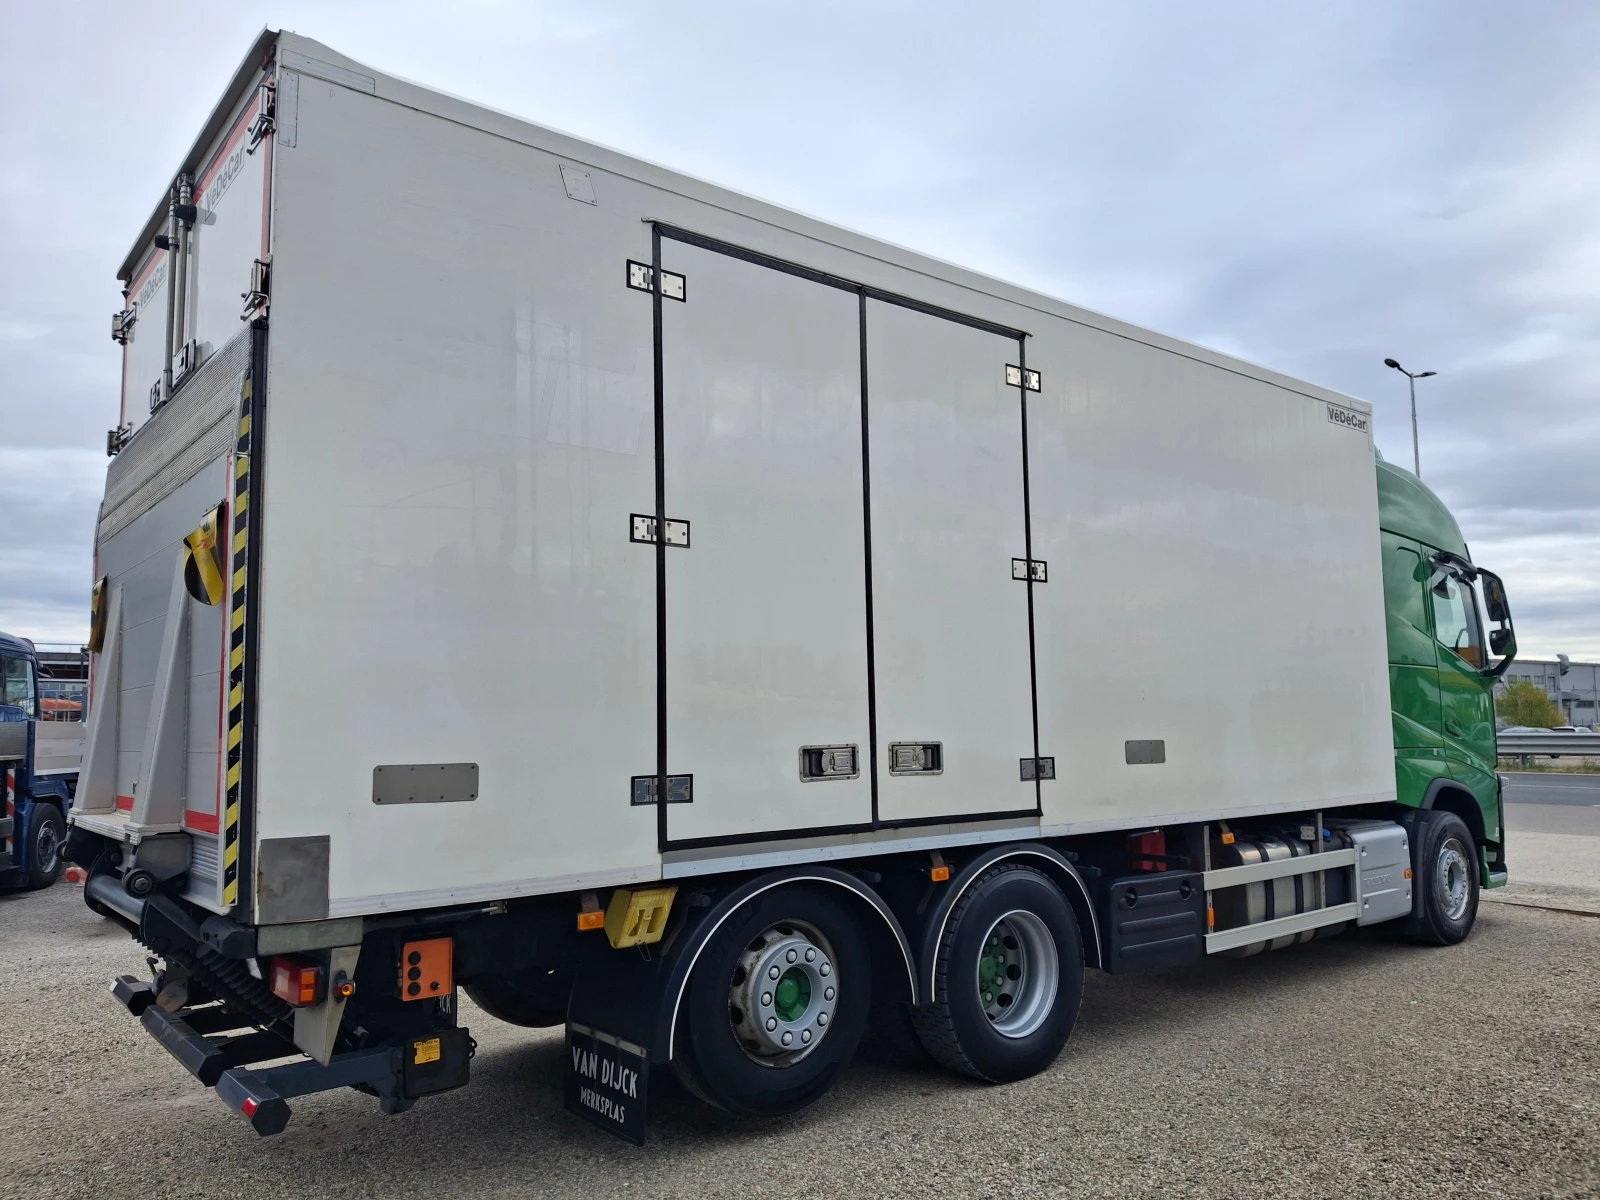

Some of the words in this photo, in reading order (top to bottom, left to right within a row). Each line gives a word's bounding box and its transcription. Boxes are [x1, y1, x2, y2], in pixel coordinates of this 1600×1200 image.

[206, 145, 245, 213] VéDéCar
[1328, 406, 1367, 430] VéDéCar
[572, 1045, 598, 1080] VAN
[601, 1058, 639, 1099] DIJCK
[580, 1086, 625, 1124] MERKSPLAS
